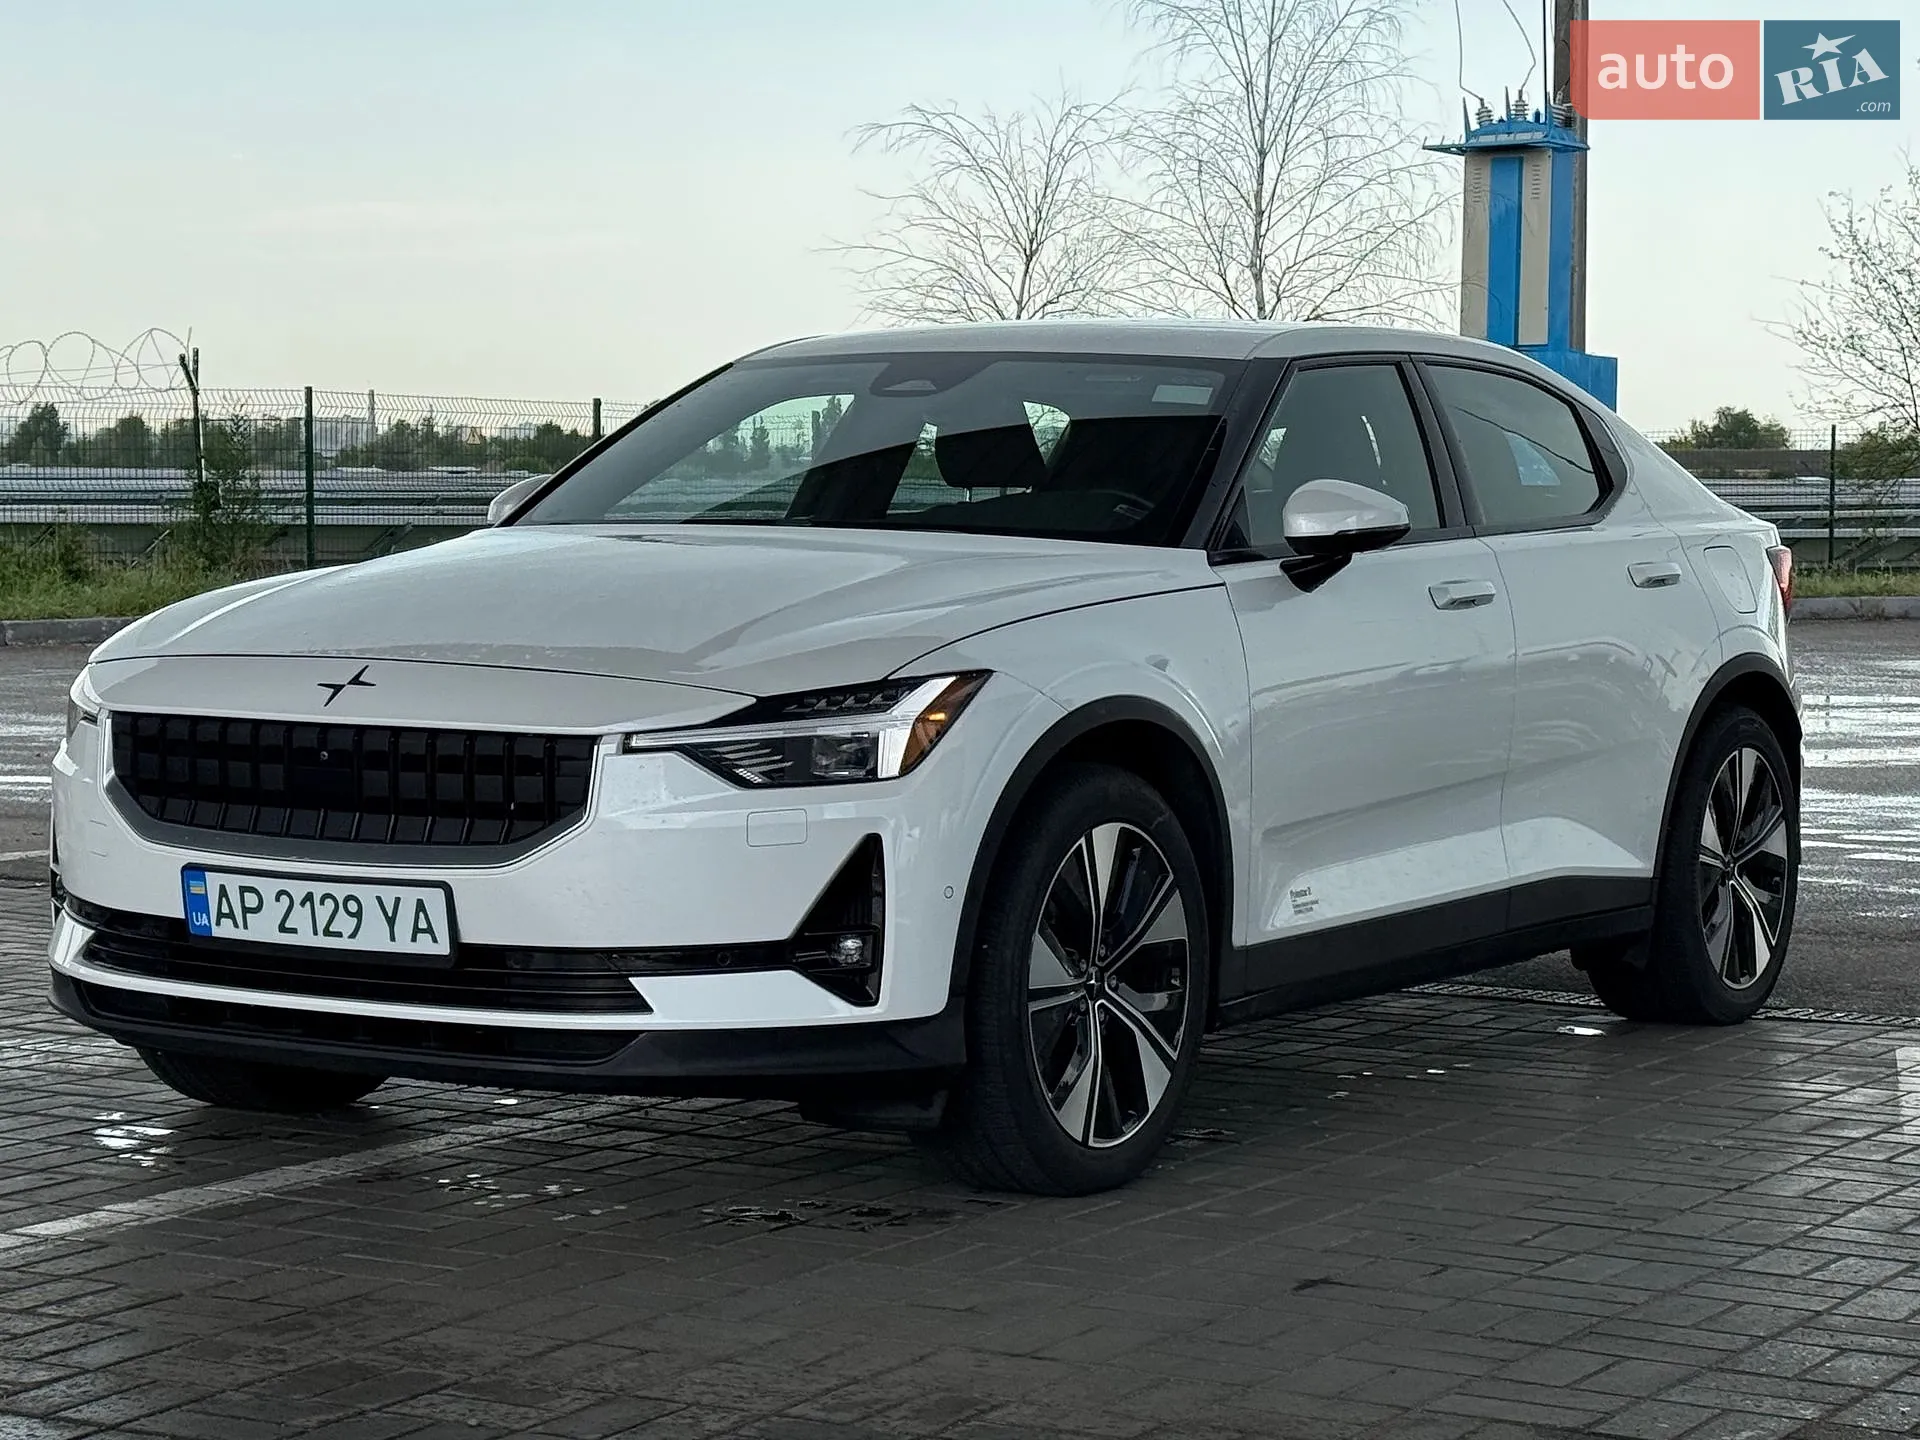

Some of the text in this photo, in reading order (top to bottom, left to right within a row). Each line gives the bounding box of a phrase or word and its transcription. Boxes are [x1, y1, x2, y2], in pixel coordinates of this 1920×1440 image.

[192, 911, 210, 927] UA
[215, 884, 439, 944] AP 2129 YA
